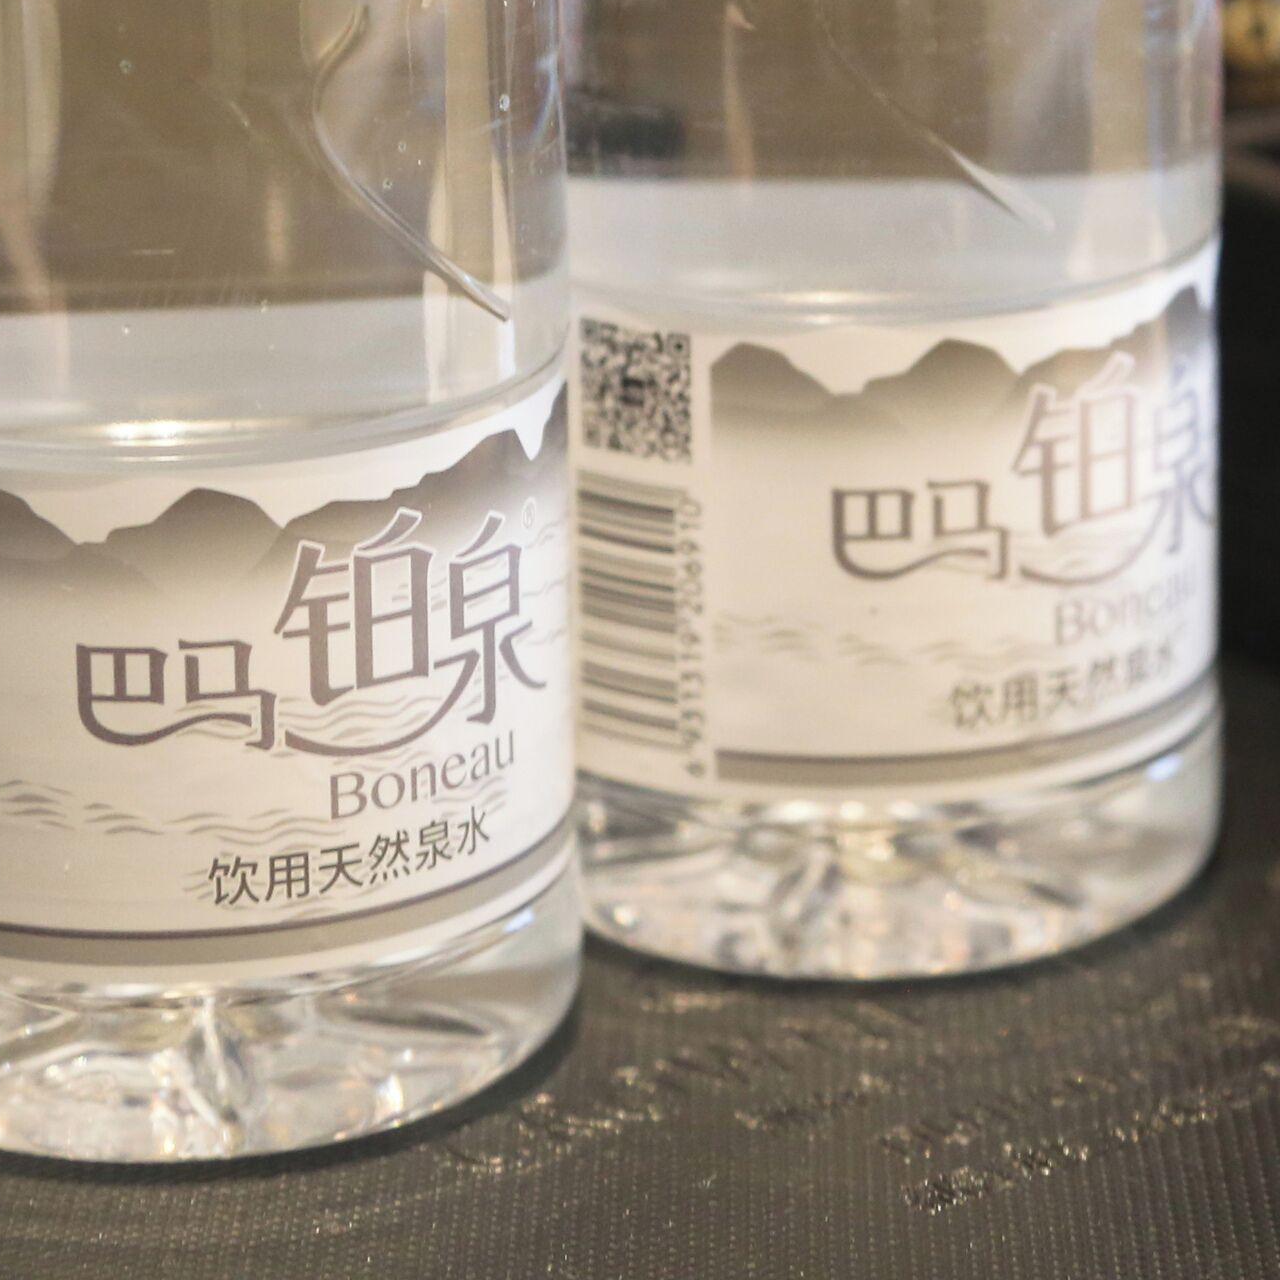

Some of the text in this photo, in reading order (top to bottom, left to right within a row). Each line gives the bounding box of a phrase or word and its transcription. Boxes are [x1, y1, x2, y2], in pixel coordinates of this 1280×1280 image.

[75, 509, 548, 757] 巴马铂泉
[329, 729, 516, 821] Boneau
[207, 805, 491, 907] 饮用天然泉水
